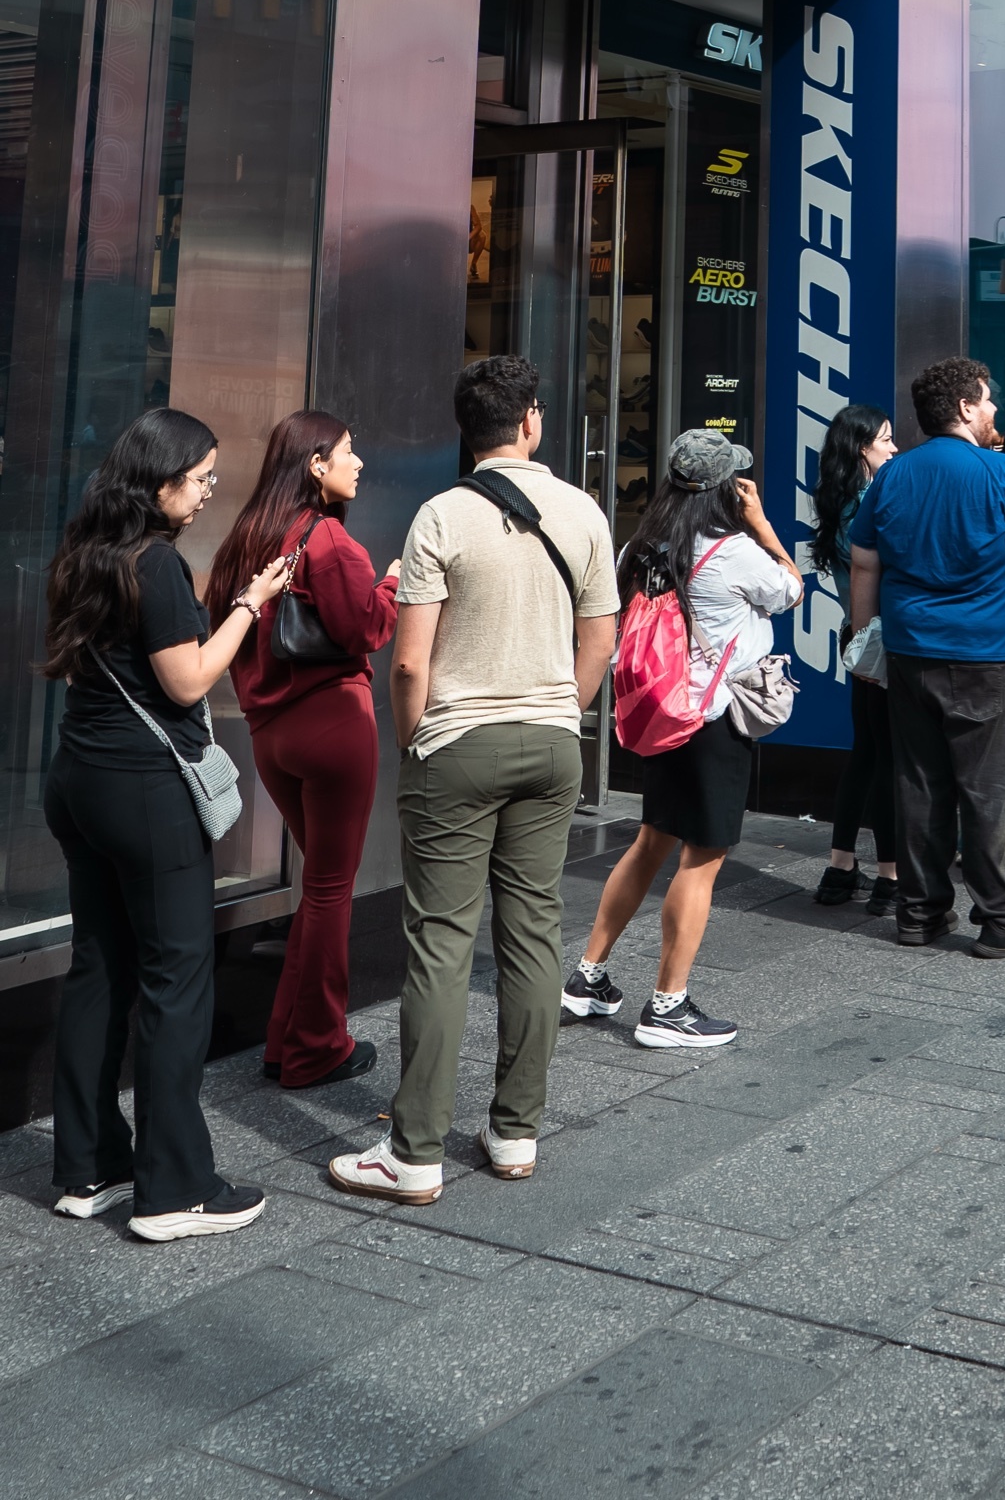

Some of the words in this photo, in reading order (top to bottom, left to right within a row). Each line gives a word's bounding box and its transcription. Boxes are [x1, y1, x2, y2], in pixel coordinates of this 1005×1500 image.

[705, 173, 748, 189] SKECHERS
[711, 187, 741, 198] RUNNING
[697, 256, 746, 271] SKECHERS
[689, 268, 745, 289] AERO
[696, 285, 758, 307] BURST
[705, 417, 737, 427] GOODYEAR
